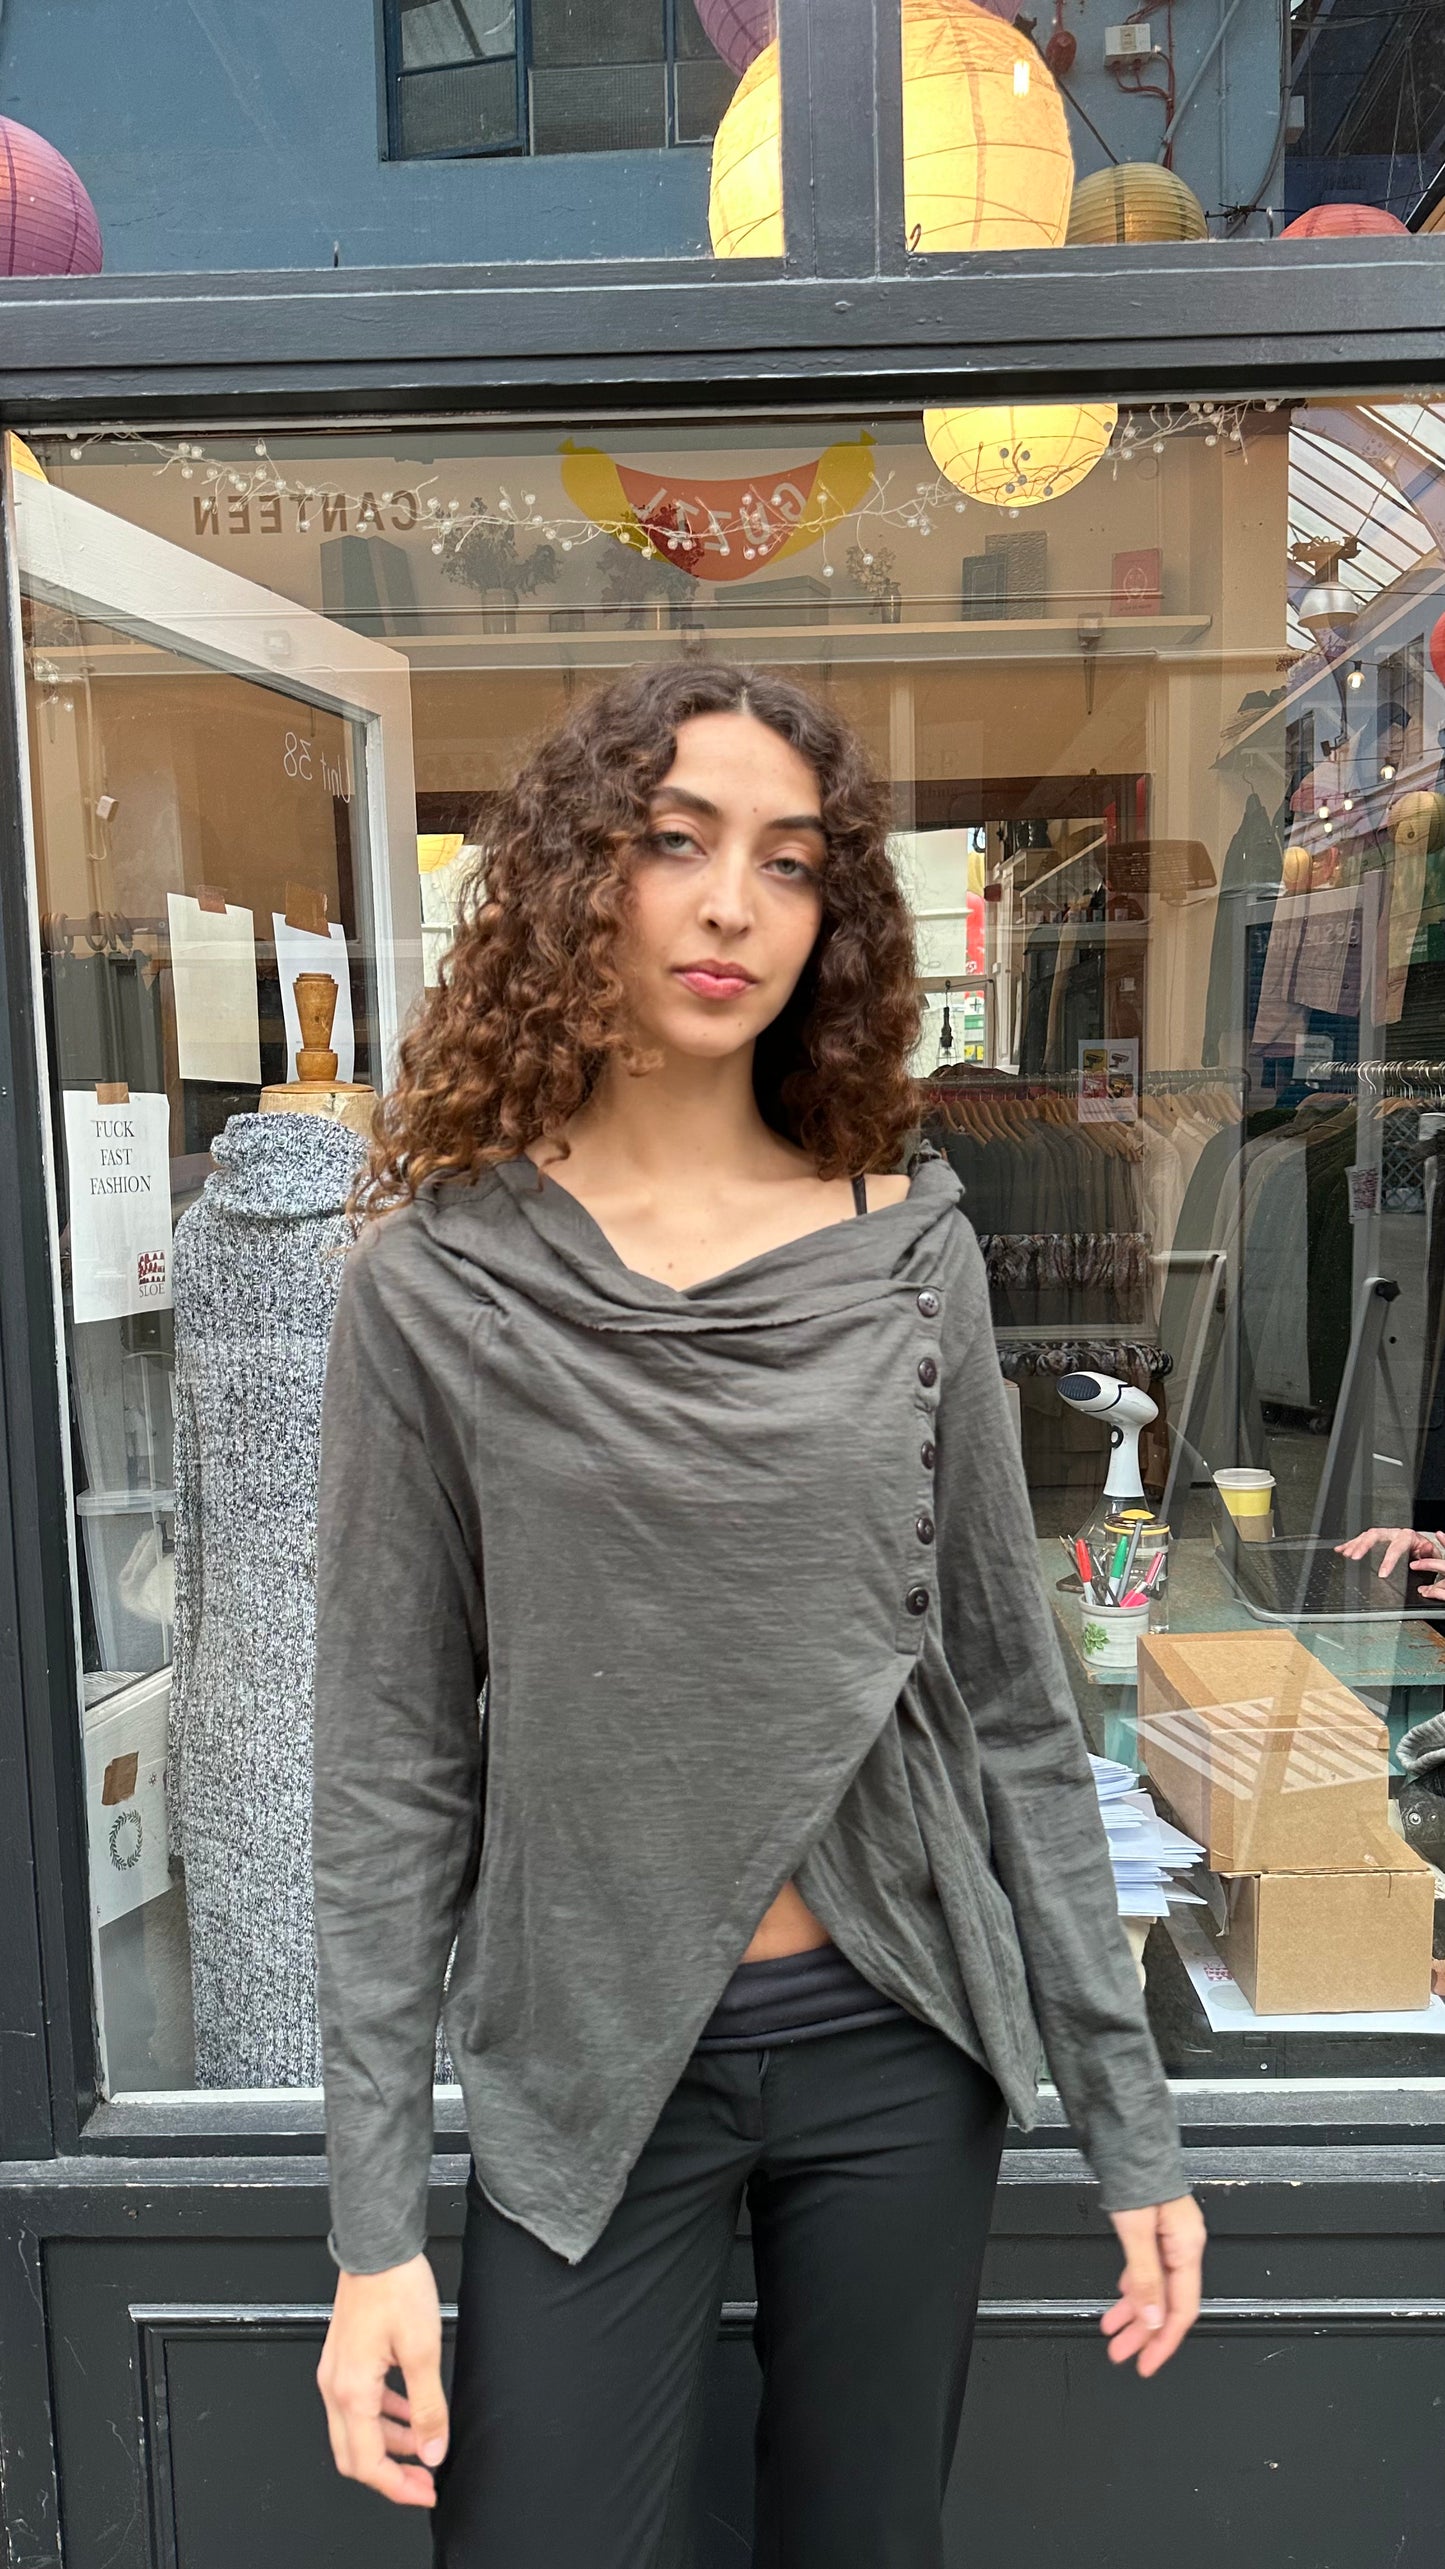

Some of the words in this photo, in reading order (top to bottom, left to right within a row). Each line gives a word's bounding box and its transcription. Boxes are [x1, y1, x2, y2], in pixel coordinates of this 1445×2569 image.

[95, 1120, 135, 1138] FUCK
[100, 1148, 133, 1166] FAST
[90, 1175, 151, 1195] FASHION
[139, 1283, 165, 1298] SLOE
